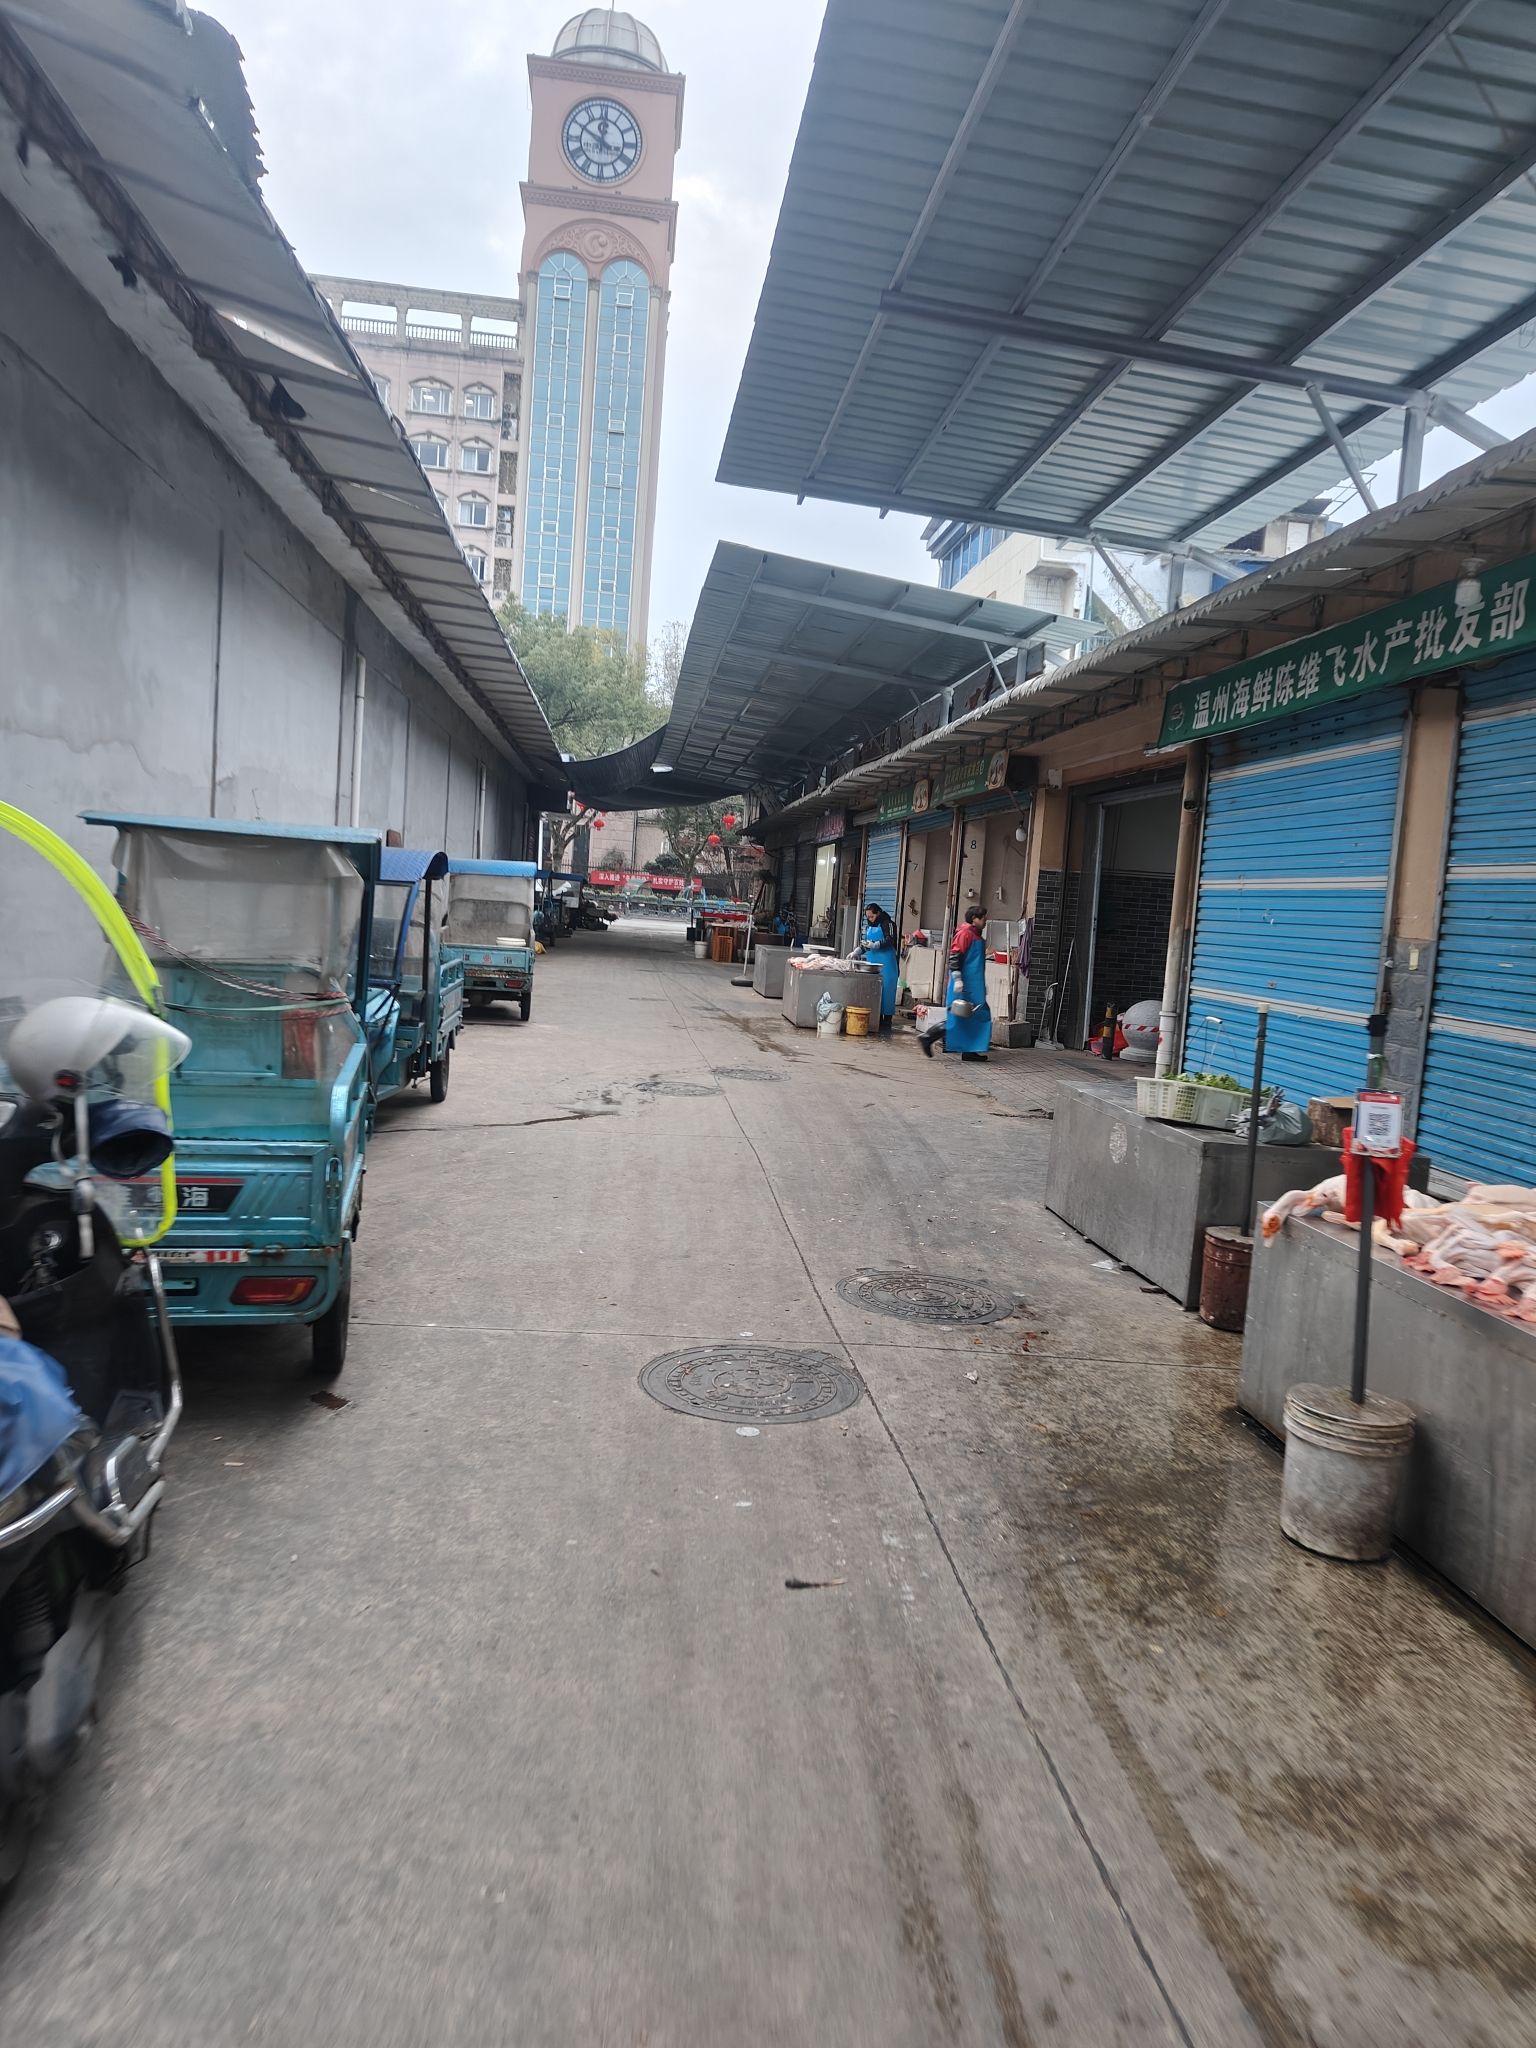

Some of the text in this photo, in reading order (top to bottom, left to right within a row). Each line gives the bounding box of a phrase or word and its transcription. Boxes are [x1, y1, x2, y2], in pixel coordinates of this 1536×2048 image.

[1191, 577, 1531, 731] 温州海鲜陈维飞水产批发部
[970, 839, 977, 850] 8
[182, 1186, 210, 1207] 海
